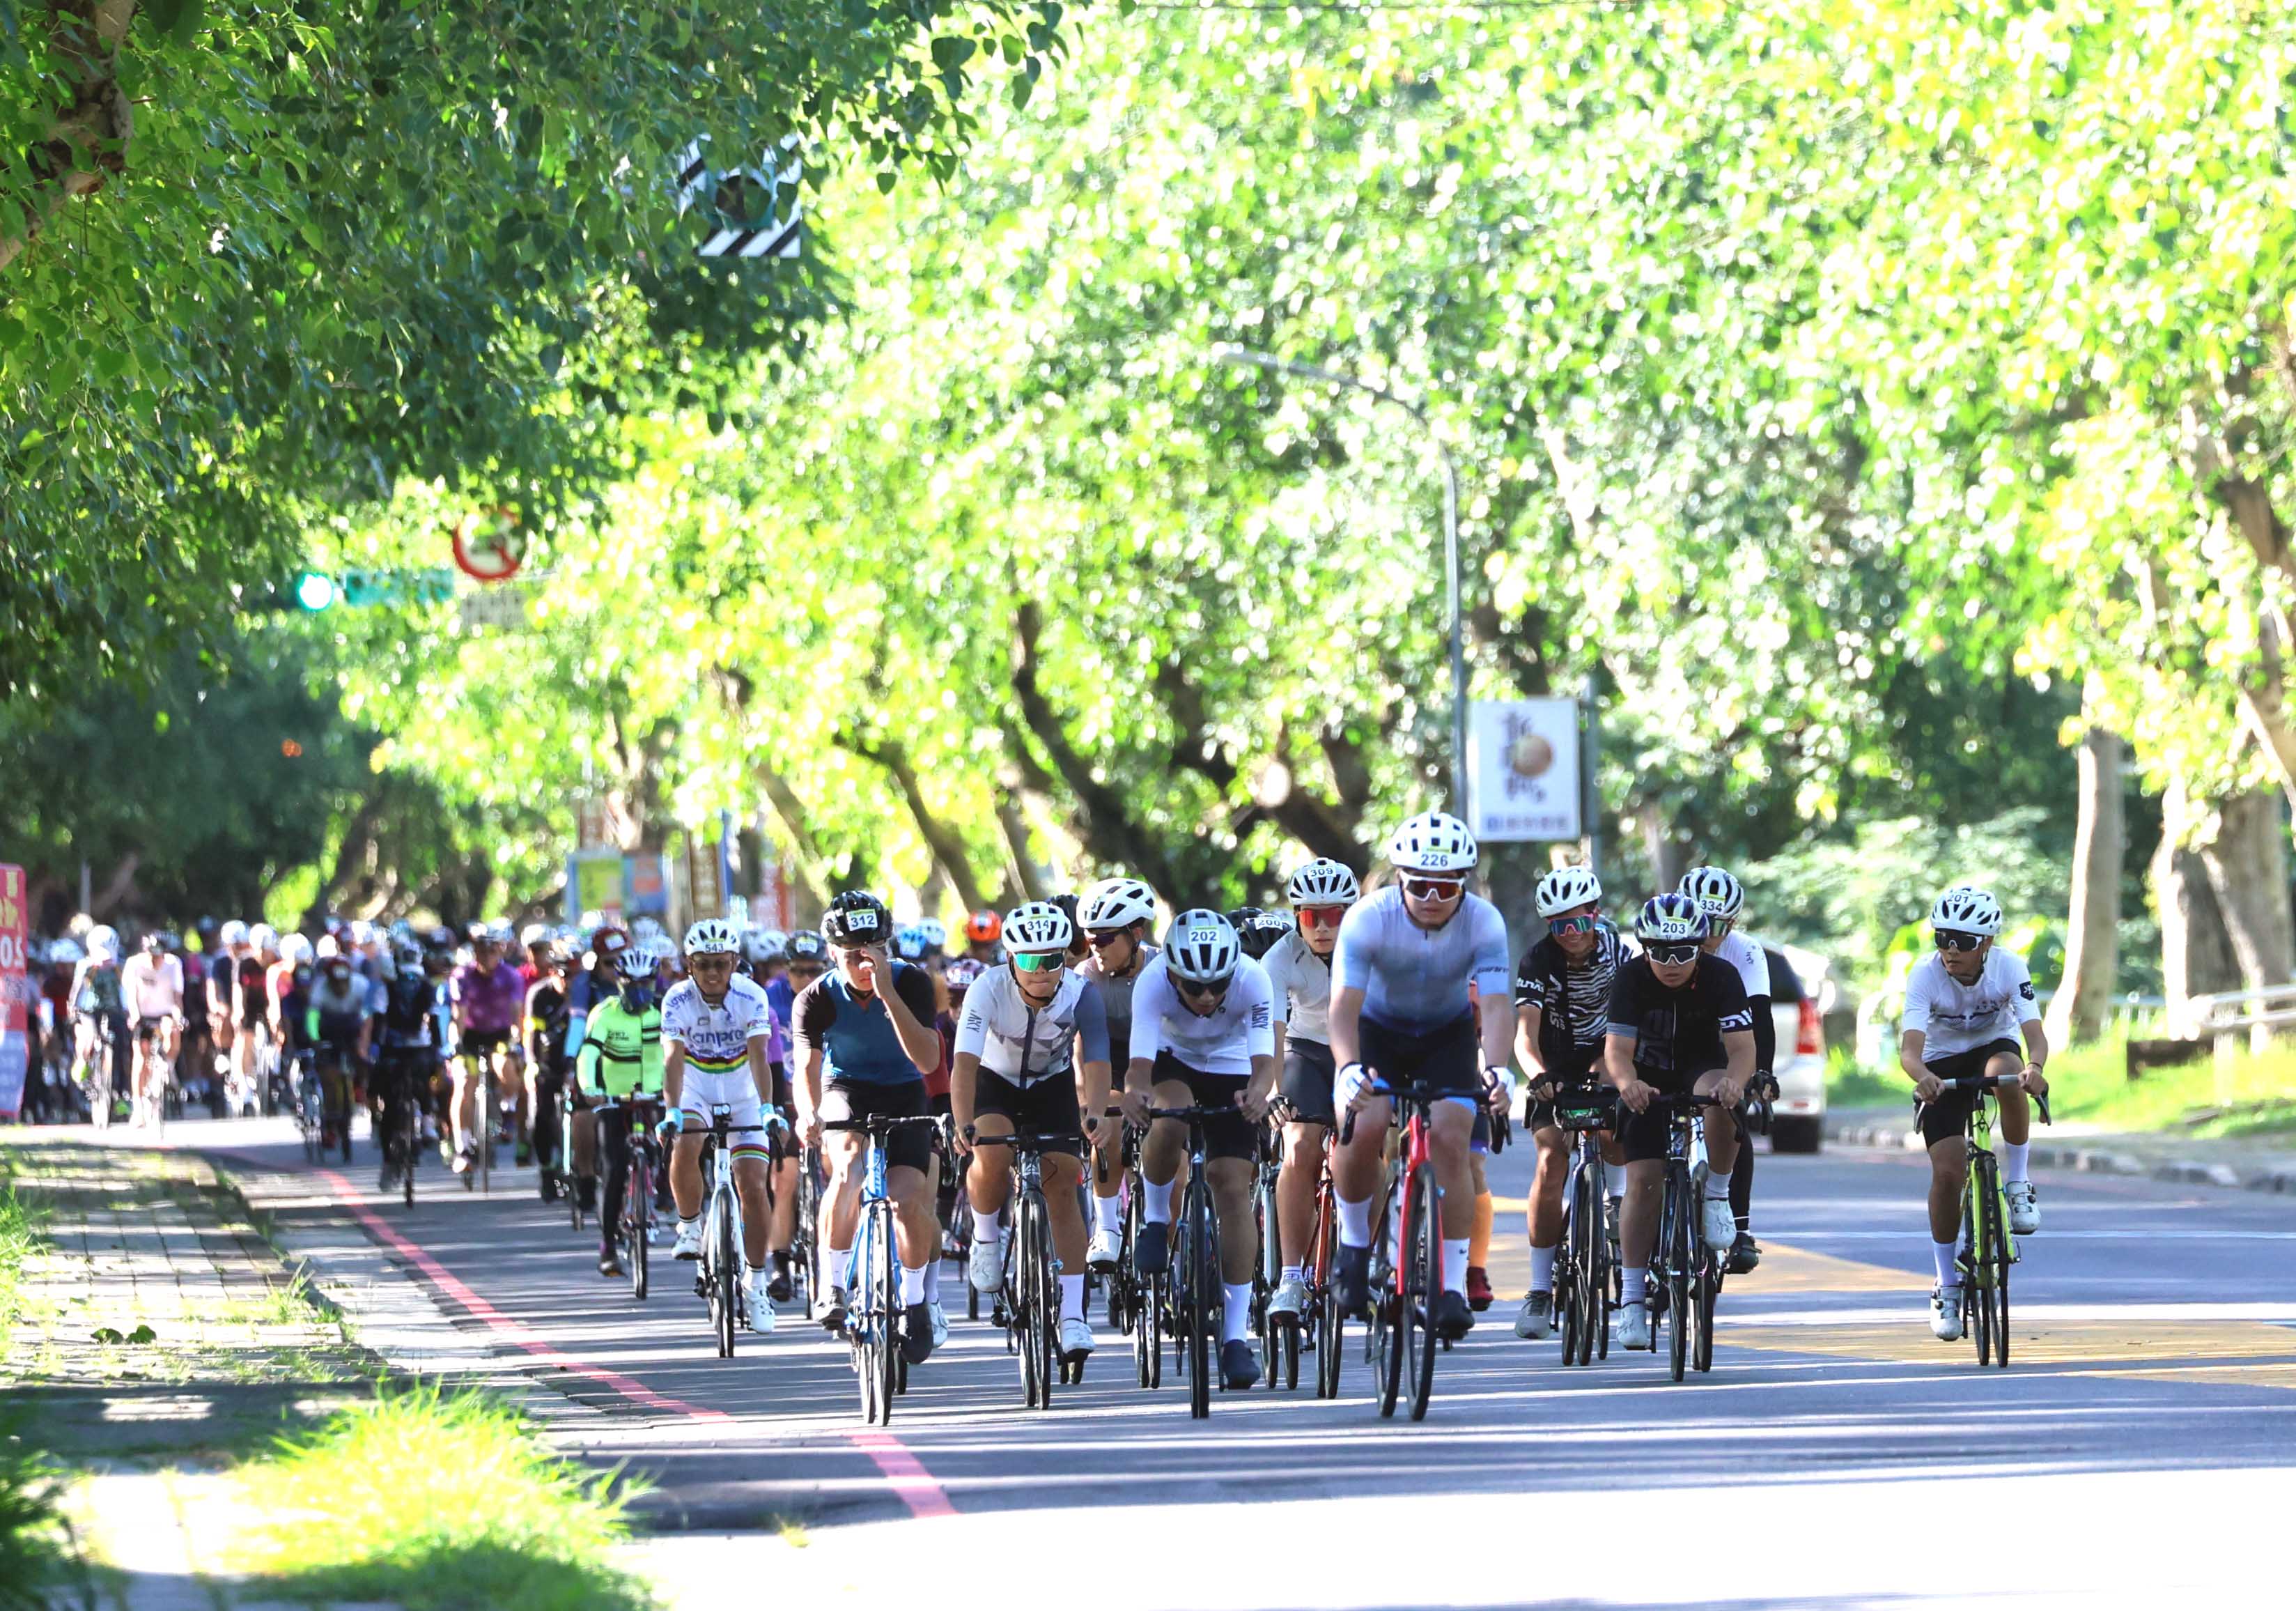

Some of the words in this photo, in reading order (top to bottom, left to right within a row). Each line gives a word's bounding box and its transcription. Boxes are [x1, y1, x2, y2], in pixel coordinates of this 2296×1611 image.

[1420, 854, 1448, 867] 226
[1310, 868, 1333, 877] 309
[1947, 894, 1969, 904] 201
[1700, 900, 1723, 913] 334
[851, 915, 876, 927] 312
[1027, 920, 1050, 931] 314
[1662, 922, 1686, 934] 203
[1190, 931, 1218, 941] 202
[705, 943, 724, 953] 543
